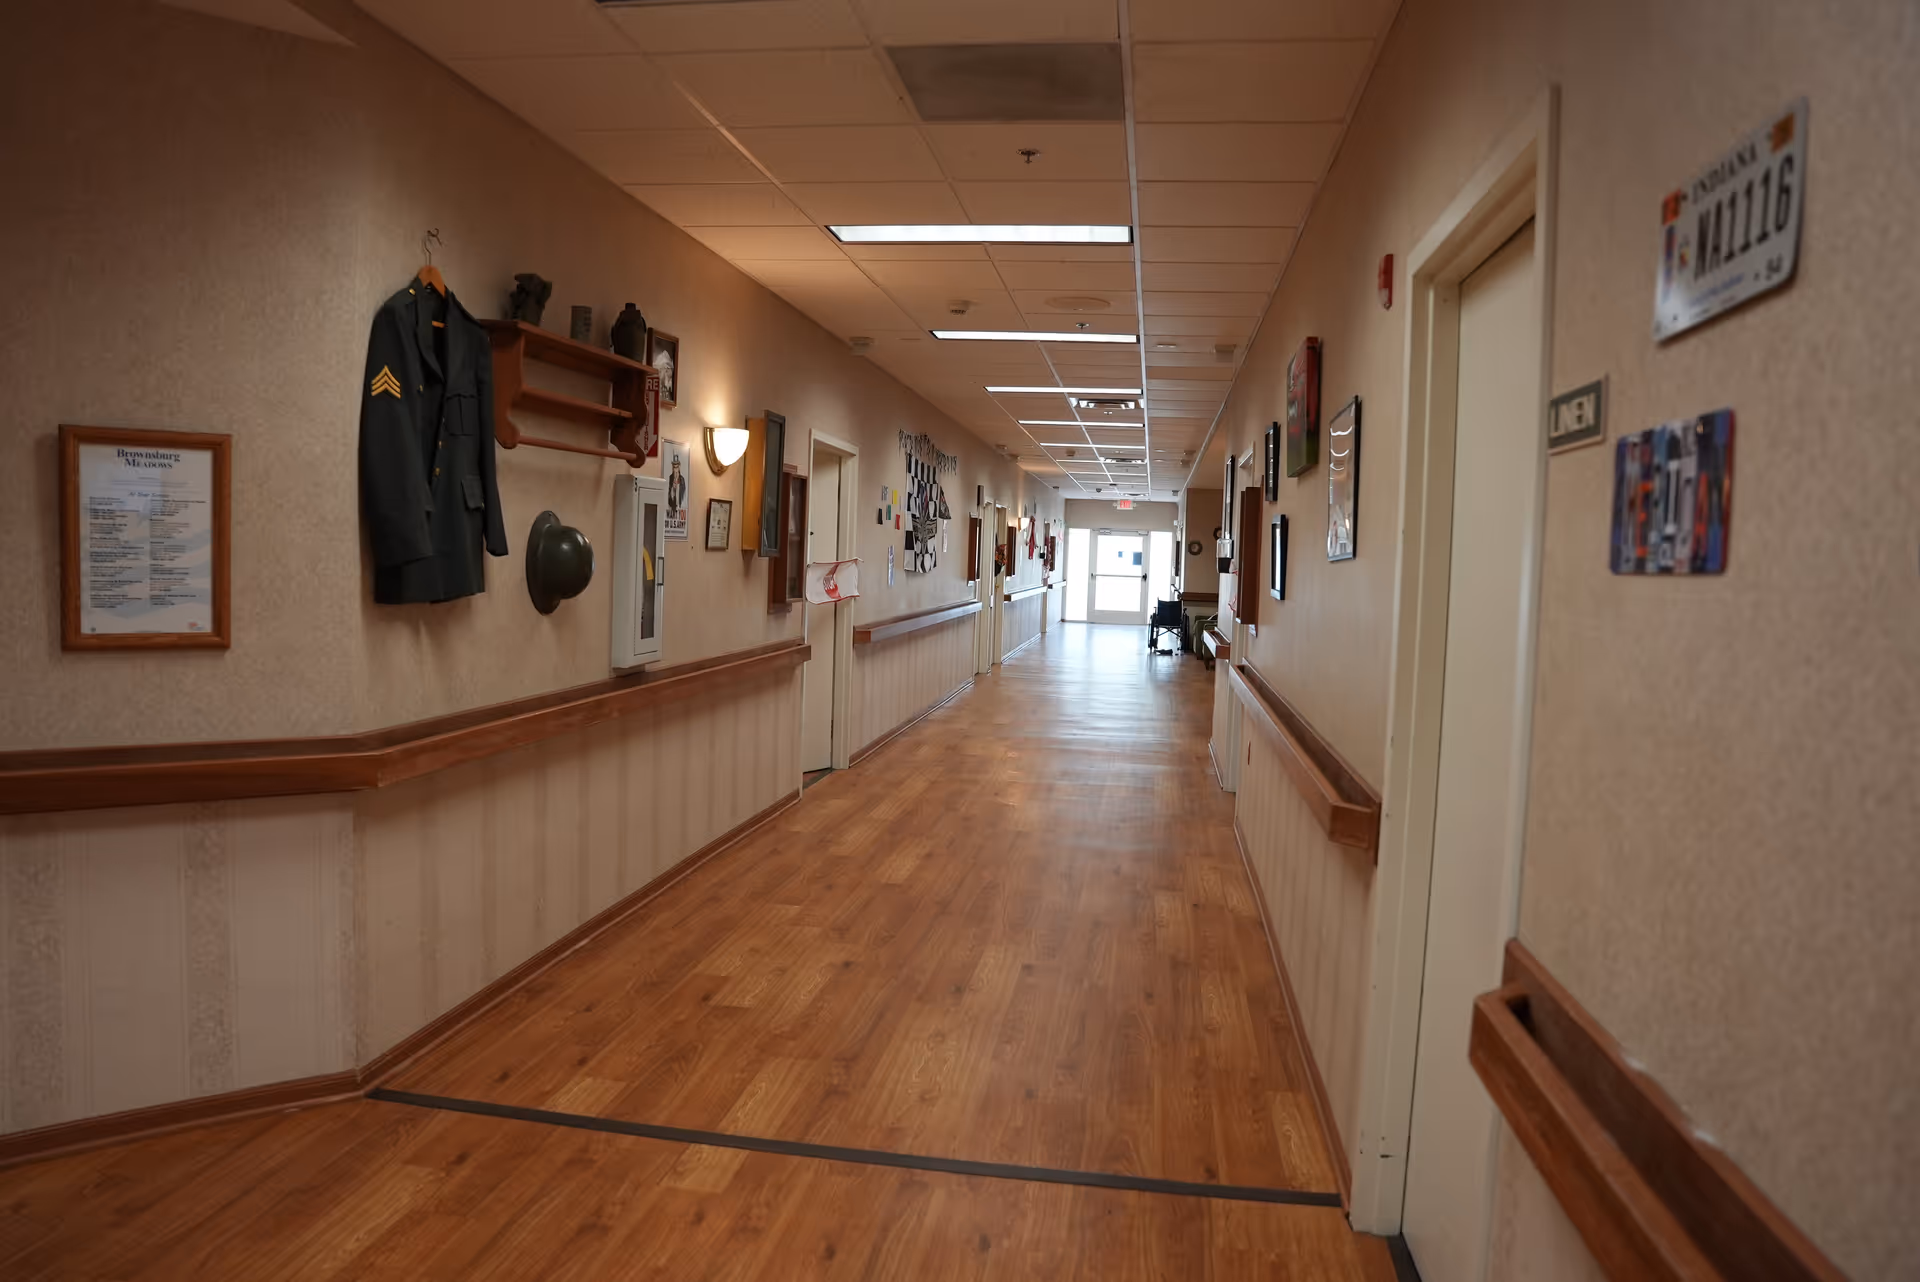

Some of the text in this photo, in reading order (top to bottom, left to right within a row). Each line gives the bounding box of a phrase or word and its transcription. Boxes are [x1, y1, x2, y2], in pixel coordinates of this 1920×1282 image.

[1691, 141, 1758, 206] INDIANA
[1550, 392, 1595, 437] LINEN
[117, 449, 181, 463] Brownsburg
[666, 509, 687, 521] WANT YOU
